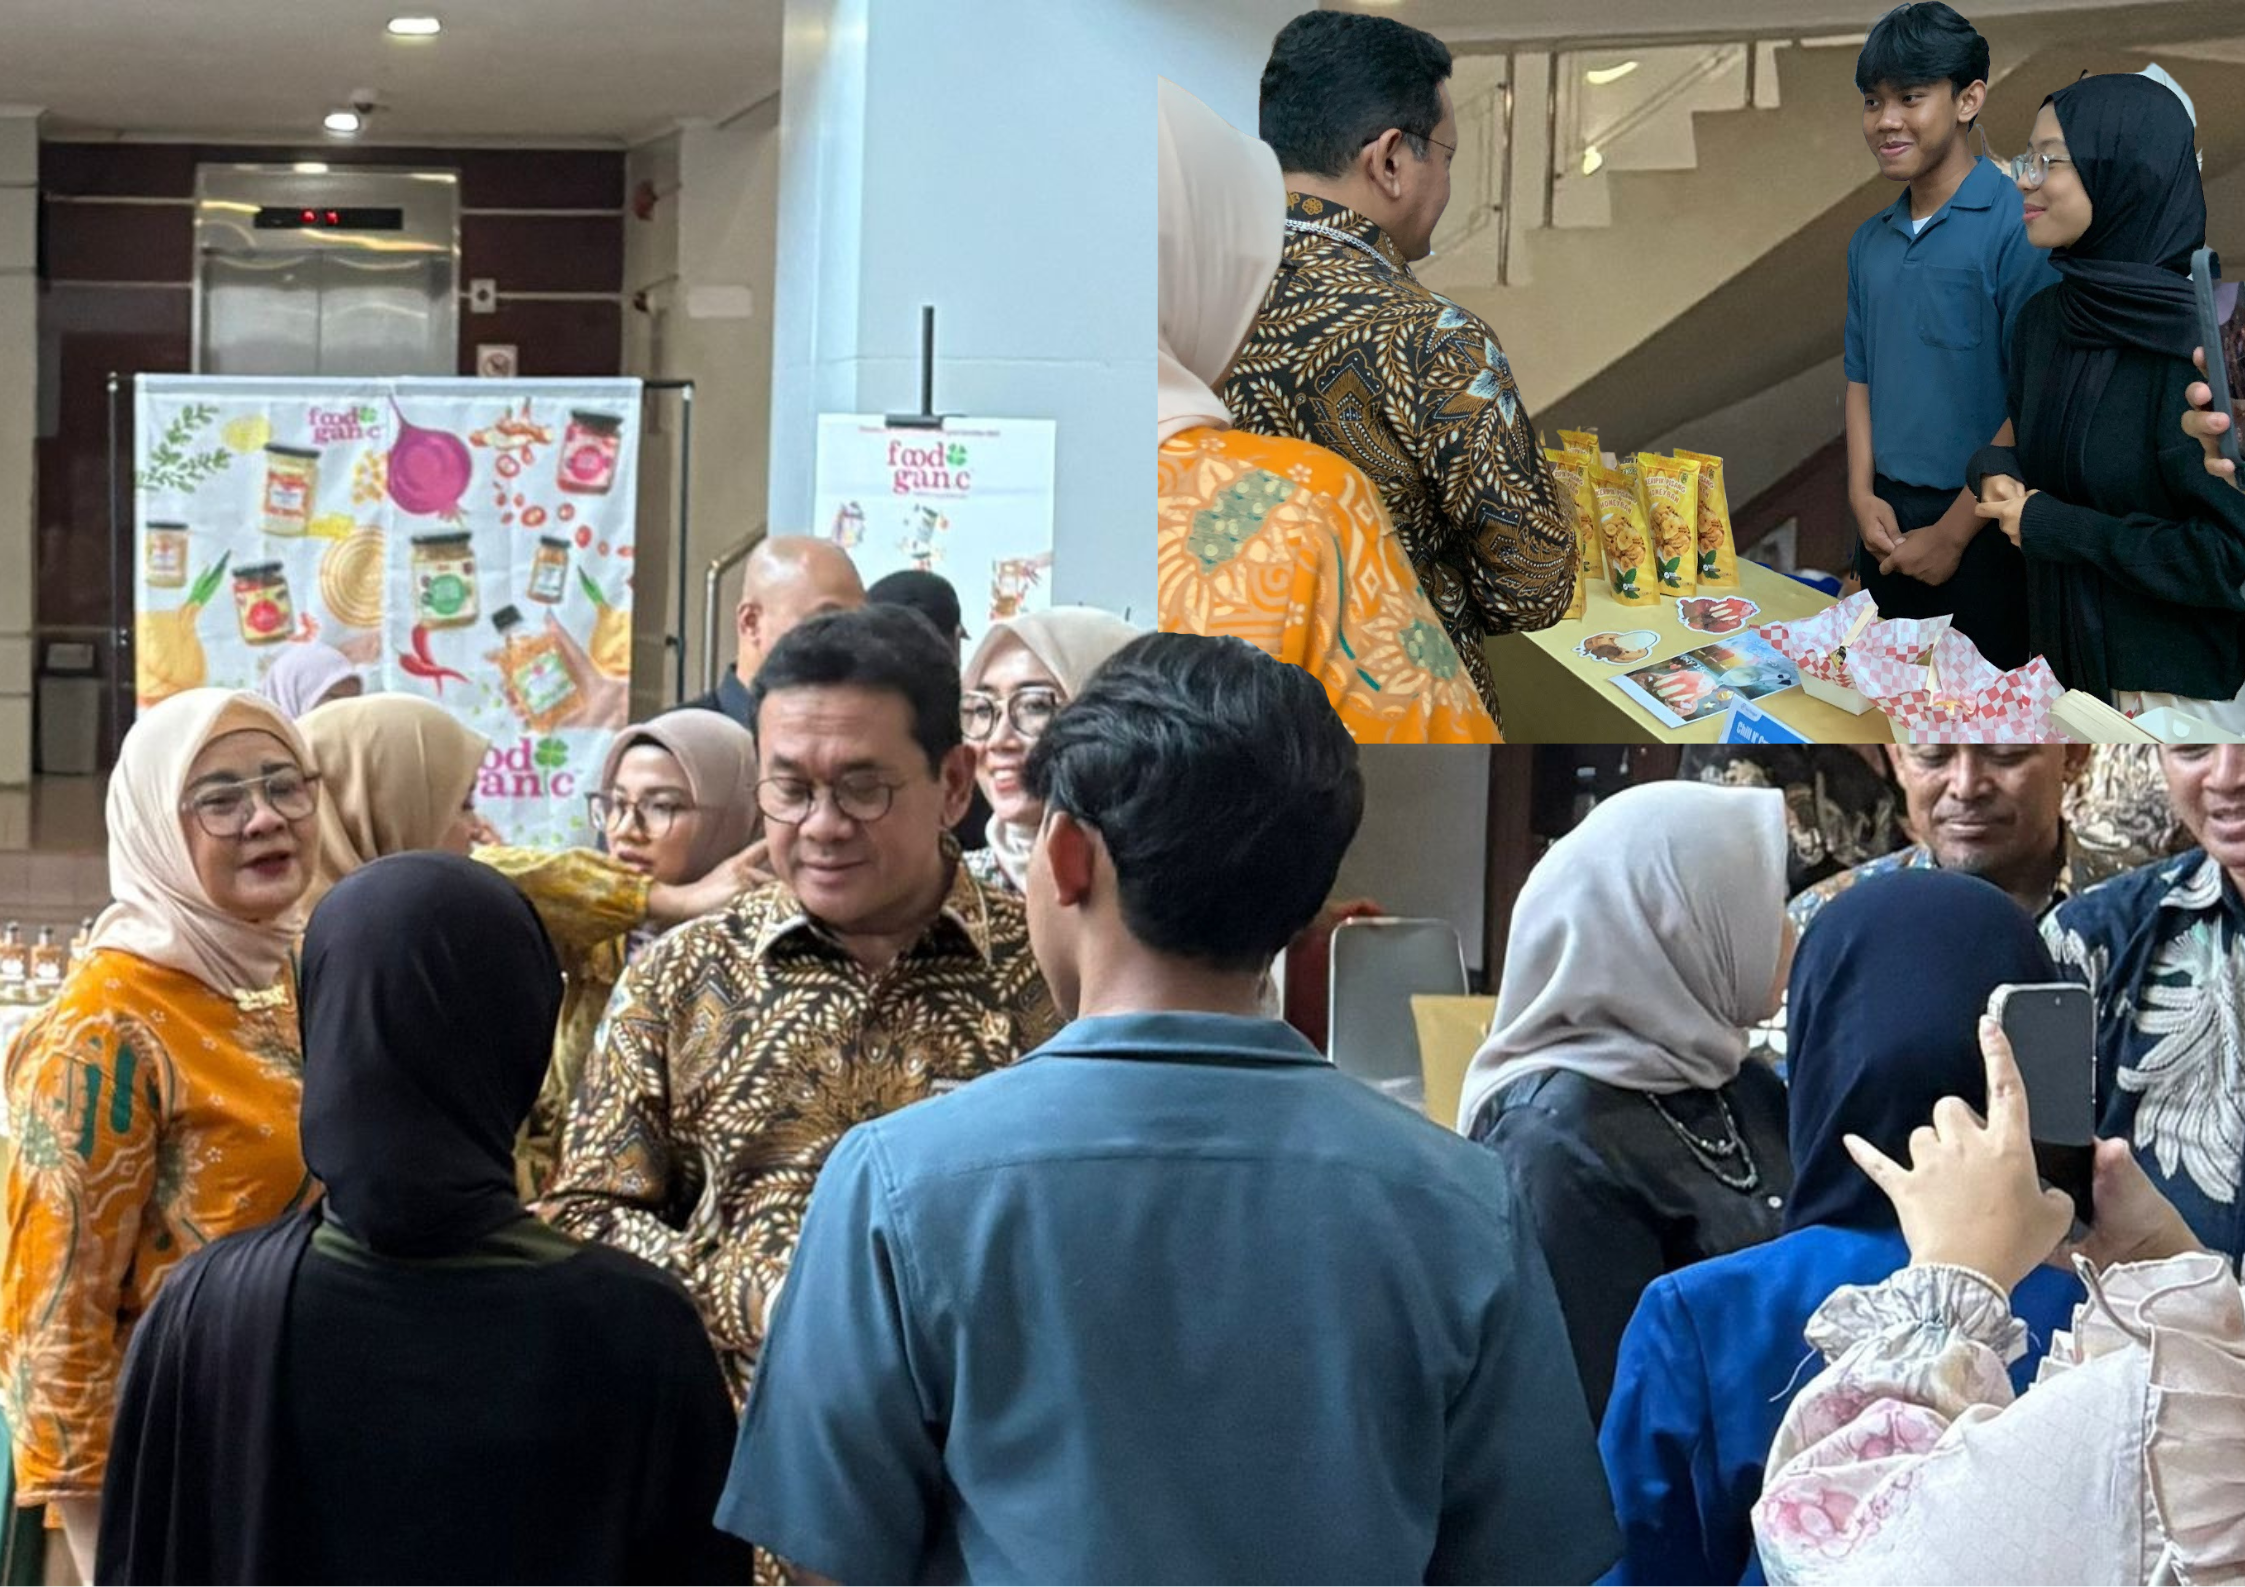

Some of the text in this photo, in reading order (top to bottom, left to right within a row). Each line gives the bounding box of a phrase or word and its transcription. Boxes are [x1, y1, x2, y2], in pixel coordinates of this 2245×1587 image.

[309, 406, 358, 425] food
[313, 427, 381, 444] ganc
[887, 439, 945, 468] food
[893, 469, 971, 494] ganc
[1666, 478, 1686, 493] PISANG
[1736, 721, 1753, 741] Chill
[482, 737, 532, 771] od
[480, 771, 576, 798] anic
